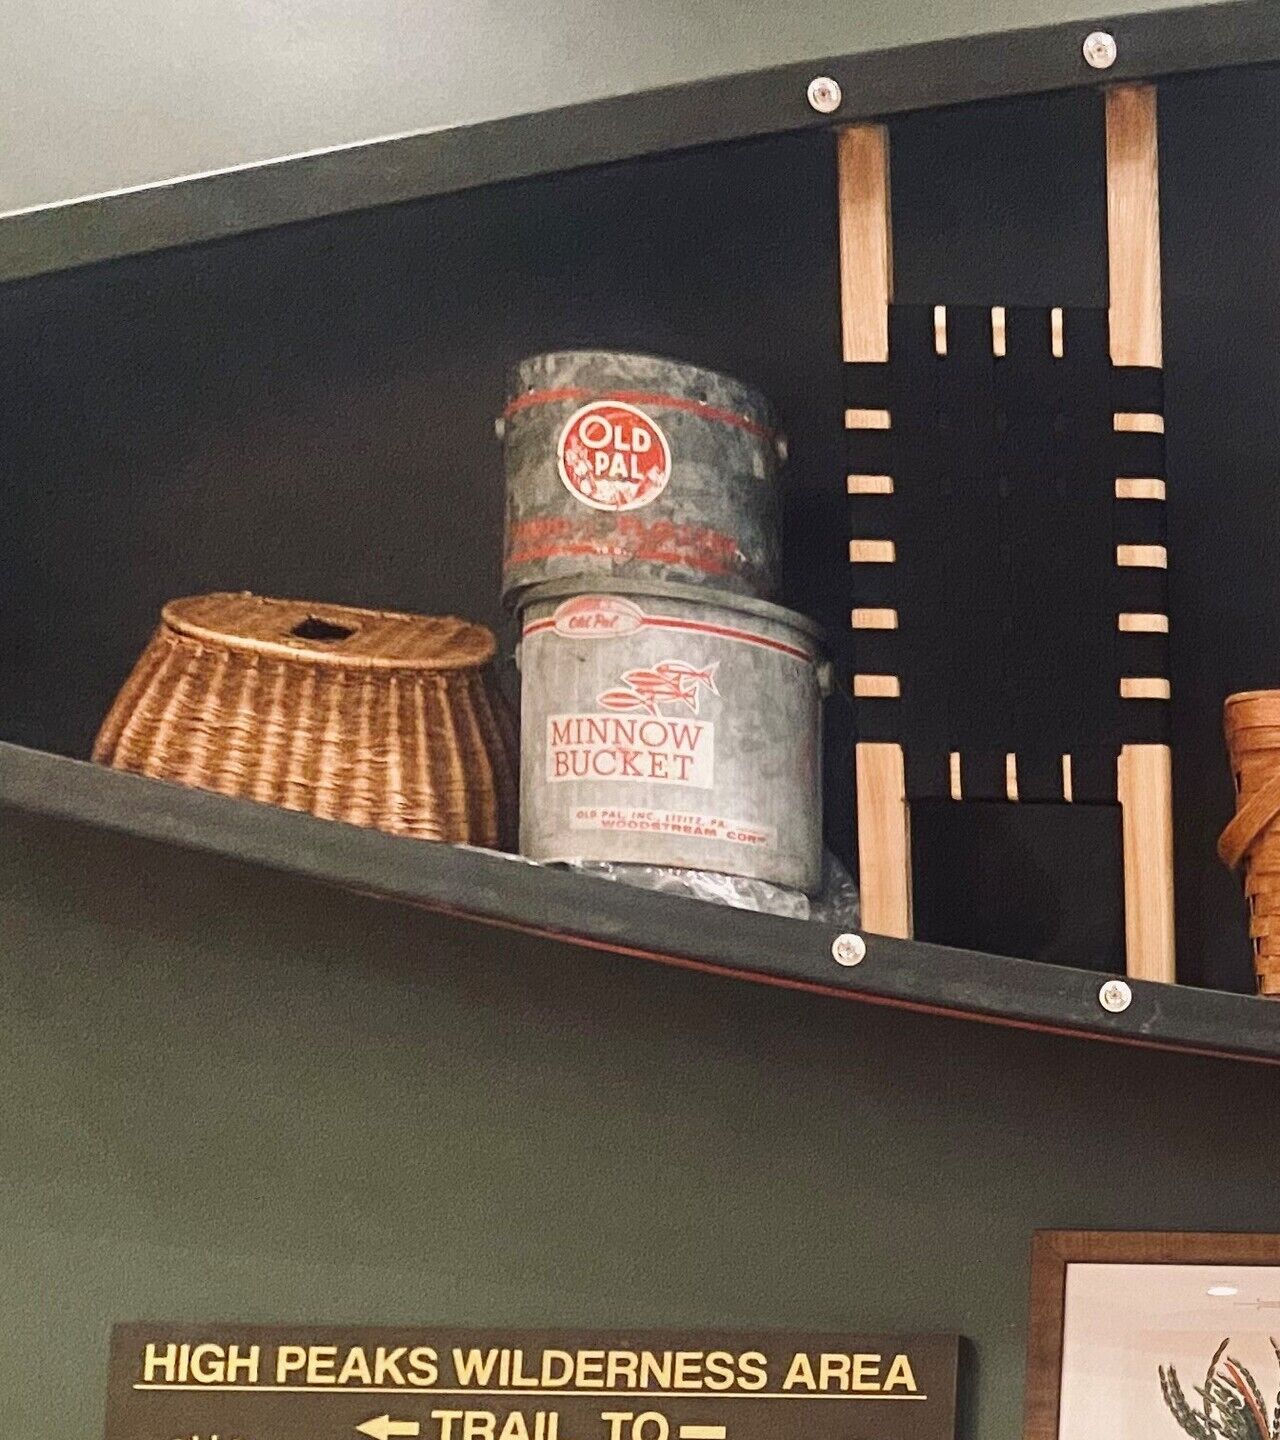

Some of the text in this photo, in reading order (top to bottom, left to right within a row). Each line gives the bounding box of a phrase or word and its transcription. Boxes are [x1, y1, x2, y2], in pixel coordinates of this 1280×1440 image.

[578, 414, 652, 453] OLD
[594, 450, 646, 481] PAL
[551, 718, 705, 751] MINNOW
[554, 747, 694, 781] BUCKET
[601, 819, 718, 838] WOODSTREAM
[143, 1343, 918, 1393] HIGH PEAKS WILDERNESS AREA
